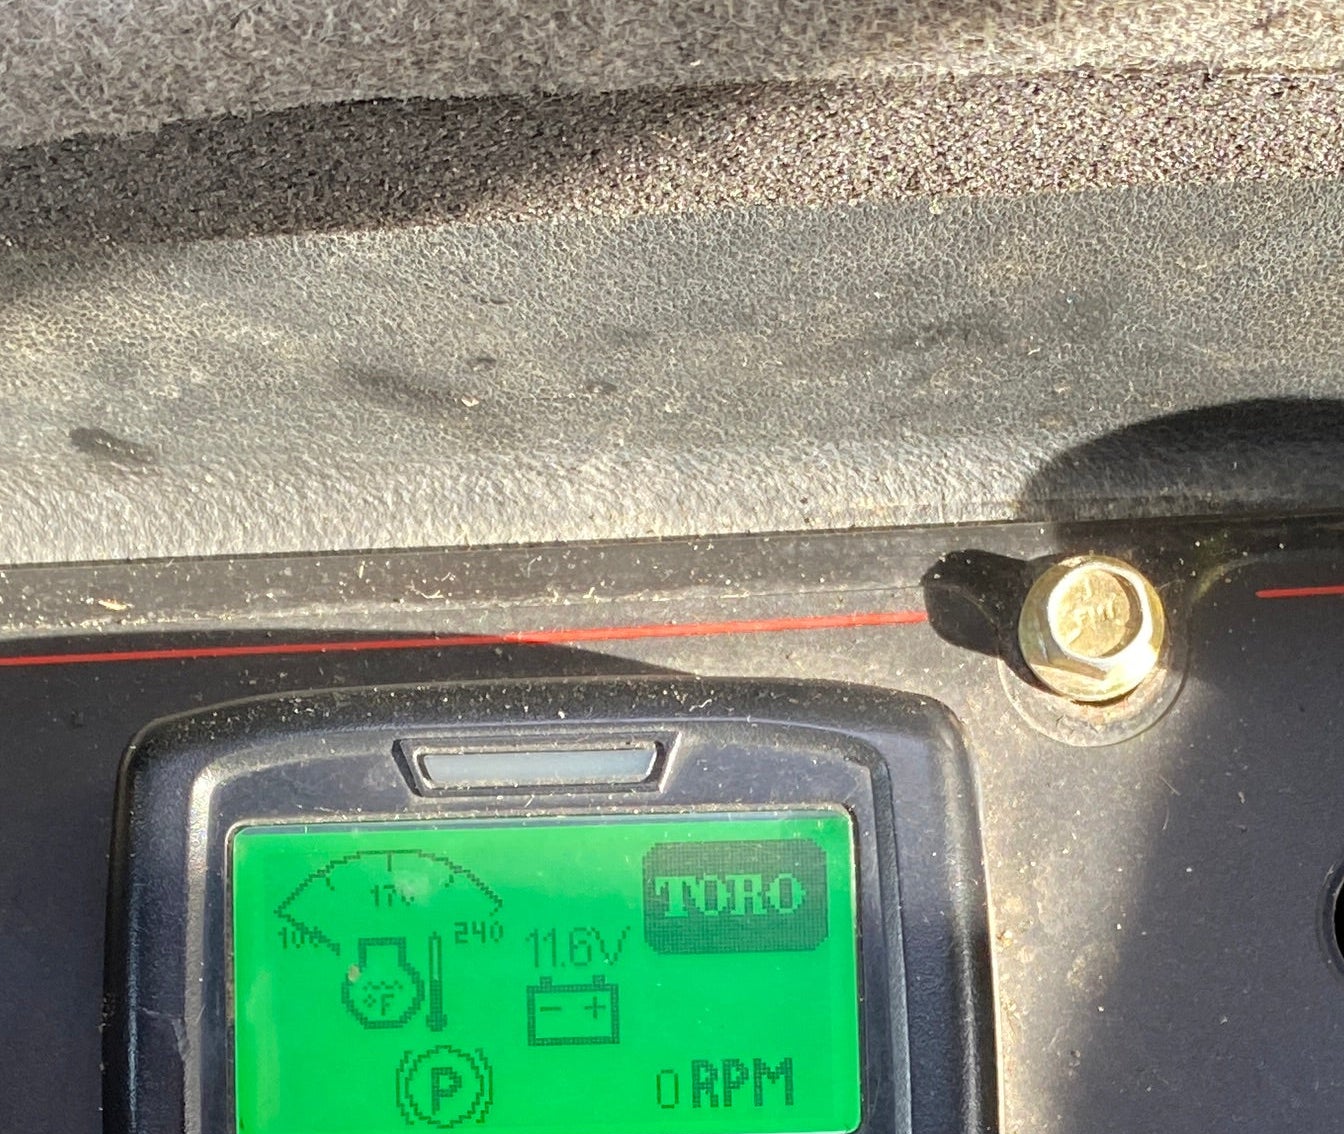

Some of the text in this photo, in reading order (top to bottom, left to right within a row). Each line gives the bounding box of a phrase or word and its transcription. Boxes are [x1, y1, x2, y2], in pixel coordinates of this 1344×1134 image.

[654, 872, 806, 918] TORO
[454, 920, 504, 944] 240
[525, 925, 631, 969] 11.6V
[655, 1057, 795, 1110] 0 RPM
